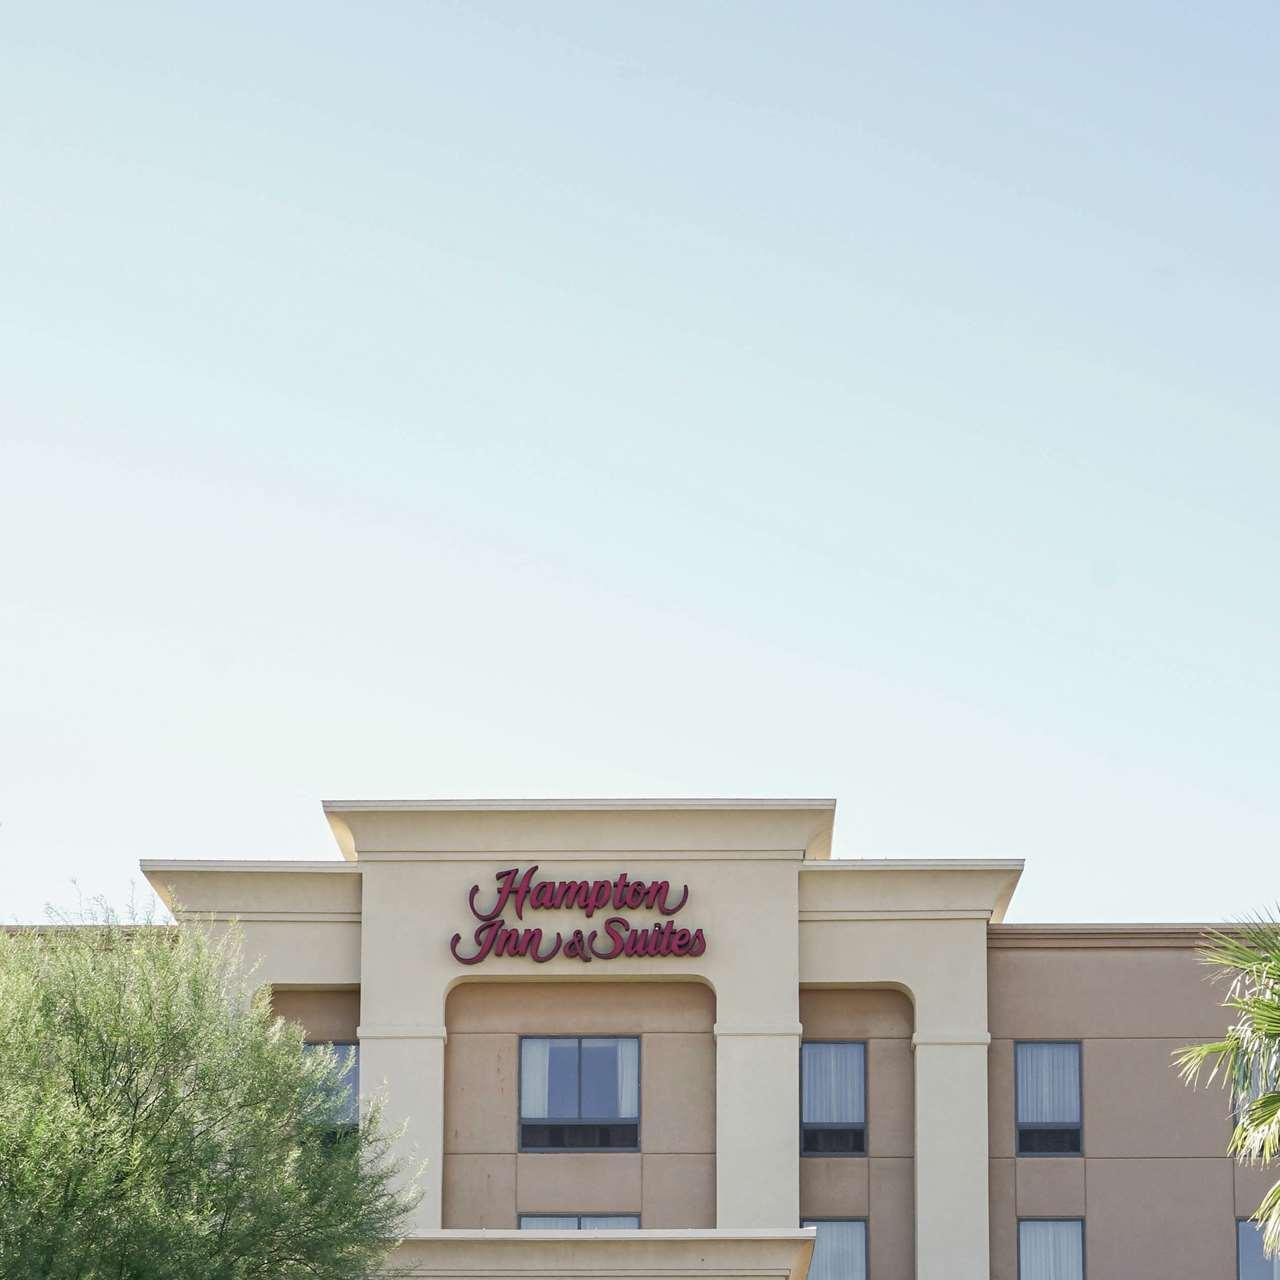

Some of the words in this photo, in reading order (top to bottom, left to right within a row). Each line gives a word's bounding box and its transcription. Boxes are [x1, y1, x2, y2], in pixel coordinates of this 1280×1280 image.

[469, 865, 689, 921] Hampton
[450, 919, 562, 965] Inn
[563, 929, 592, 962] &
[587, 916, 707, 959] Suites
